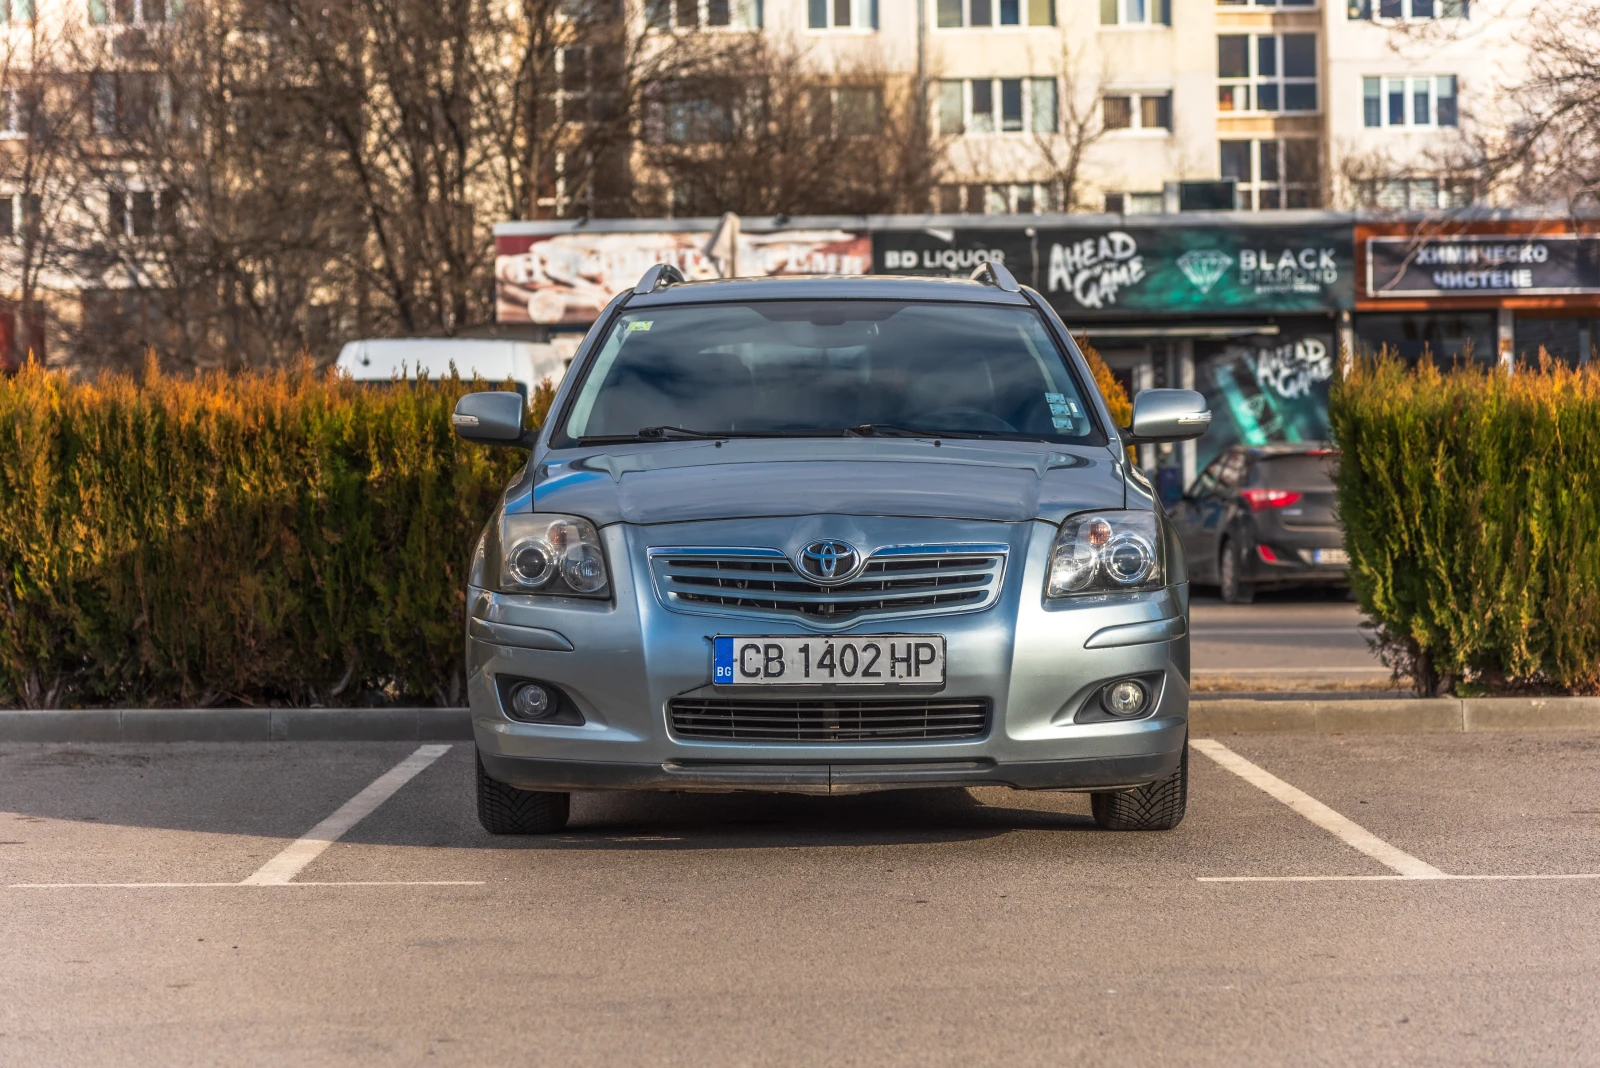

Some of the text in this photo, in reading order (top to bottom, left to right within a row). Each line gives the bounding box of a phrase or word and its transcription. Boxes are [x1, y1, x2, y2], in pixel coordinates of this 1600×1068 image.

[884, 249, 1005, 271] BD LIQUOR
[1239, 248, 1337, 270] BLACK
[1415, 244, 1549, 265] ХИМИЧЕСКО
[1048, 231, 1137, 302] AHEAD
[1239, 268, 1338, 285] DIAMOND
[1073, 256, 1147, 309] GAME
[1432, 268, 1534, 288] ЧИСТЕНЕ
[716, 666, 732, 677] BG
[798, 643, 882, 678] 1402
